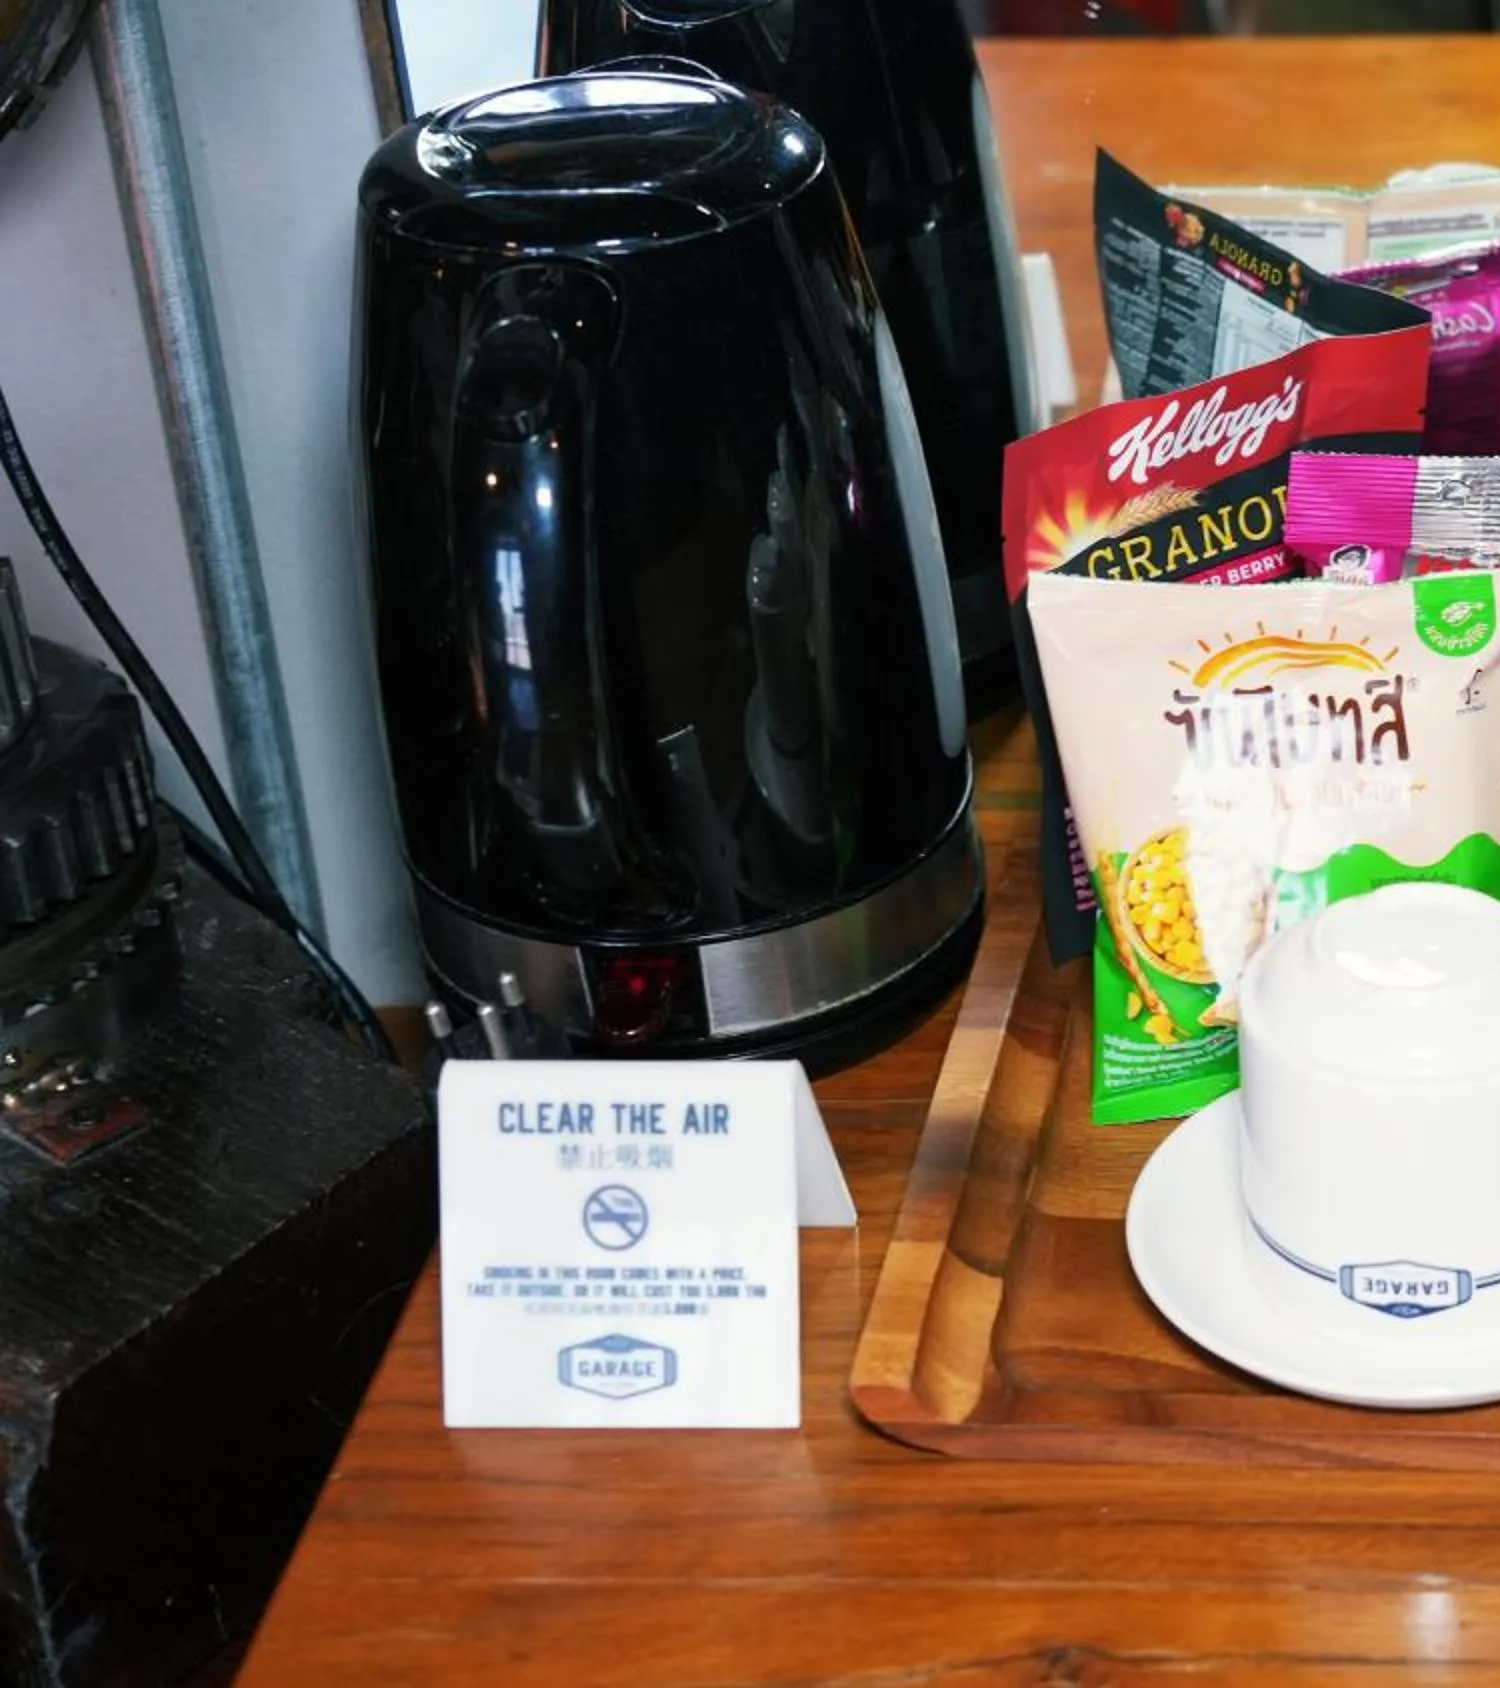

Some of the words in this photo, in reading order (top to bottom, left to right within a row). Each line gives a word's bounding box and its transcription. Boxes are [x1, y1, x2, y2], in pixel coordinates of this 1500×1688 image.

[1108, 376, 1303, 484] Kellogg's
[1227, 551, 1285, 583] BERRY
[499, 1102, 594, 1135] CLEAR
[611, 1102, 667, 1135] THE
[682, 1102, 730, 1135] AIR
[1363, 1276, 1449, 1296] GARAGE
[578, 1360, 657, 1377] GARAGE
